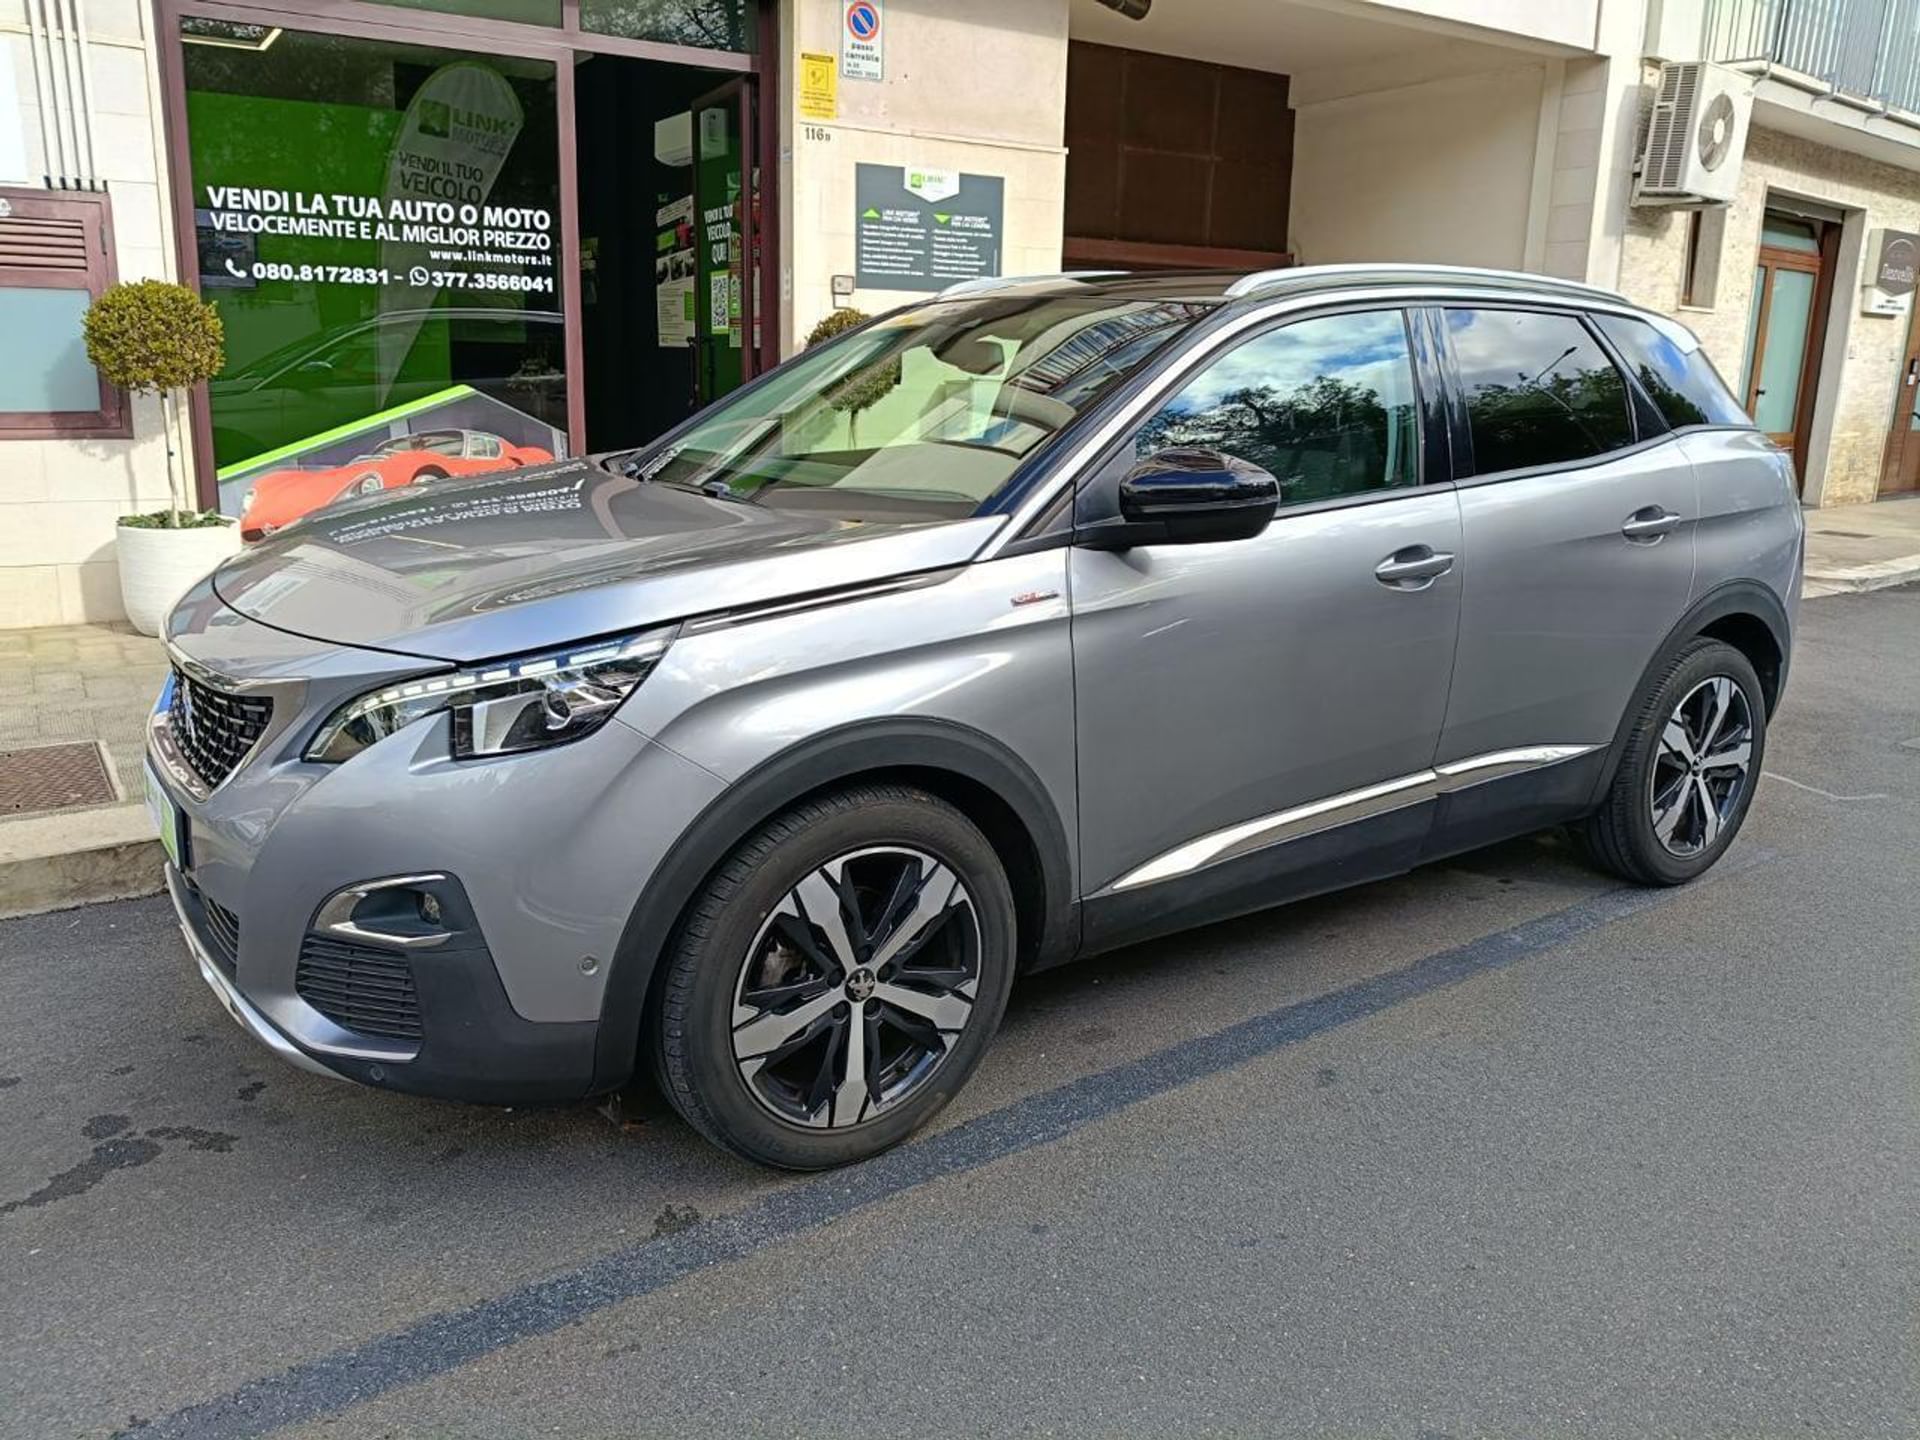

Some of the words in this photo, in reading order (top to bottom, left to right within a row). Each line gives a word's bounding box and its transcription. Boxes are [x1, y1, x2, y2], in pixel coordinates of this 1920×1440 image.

[400, 169, 482, 204] VEICOLO
[455, 162, 484, 183] TUO
[206, 185, 290, 213] VENDI
[295, 191, 329, 216] LA
[331, 194, 384, 220] TUA
[388, 199, 455, 224] AUTO
[459, 204, 479, 226] O
[483, 206, 551, 231] MOTO
[209, 211, 358, 239] VELOCEMENTE
[360, 221, 372, 240] E
[375, 222, 400, 242] AL
[402, 225, 481, 247] MIGLIOR
[483, 229, 551, 251] PREZZO
[429, 250, 553, 266] www.linkmotors.it
[252, 262, 389, 286] 080.8172831
[431, 271, 554, 293] 377.3566041
